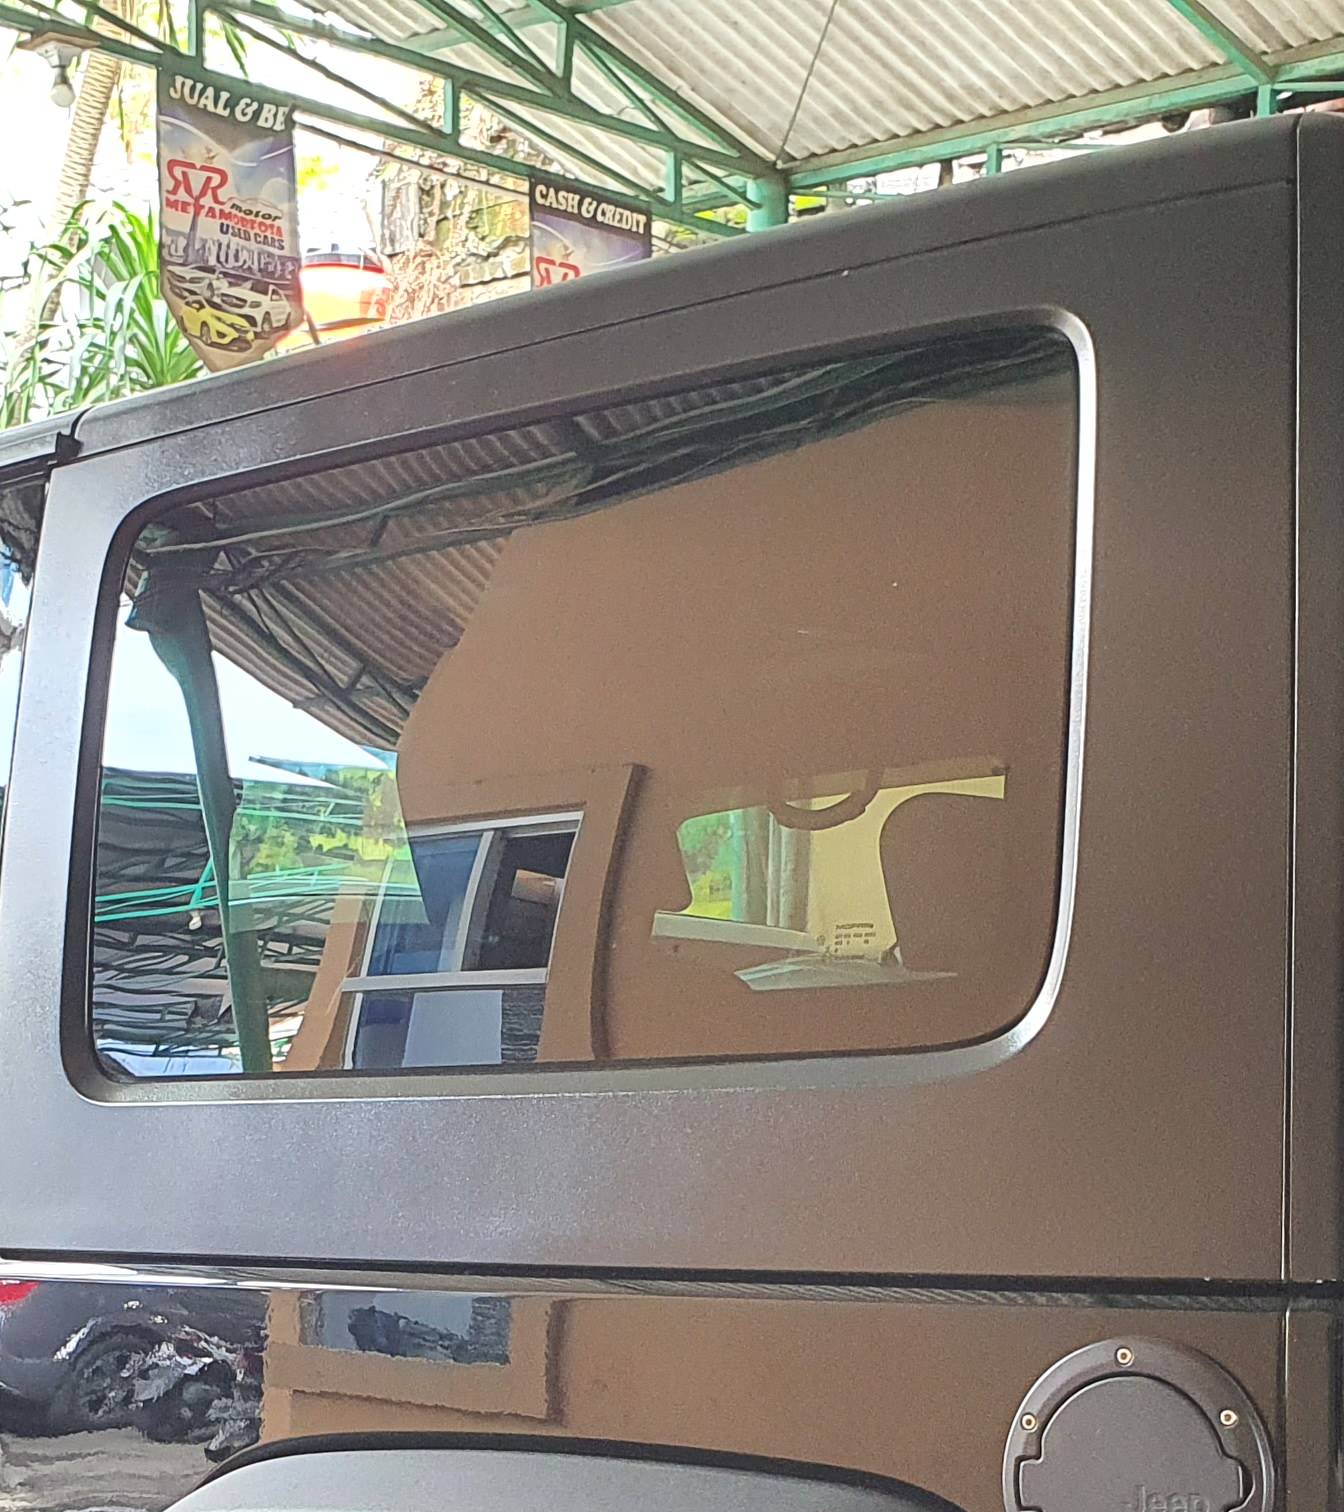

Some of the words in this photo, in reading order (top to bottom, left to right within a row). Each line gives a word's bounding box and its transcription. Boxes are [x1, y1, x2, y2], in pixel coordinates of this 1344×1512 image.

[169, 75, 231, 117] JUAL
[234, 98, 259, 122] &
[535, 184, 580, 214] CASH
[581, 197, 598, 218] &
[596, 202, 647, 235] CREDIT
